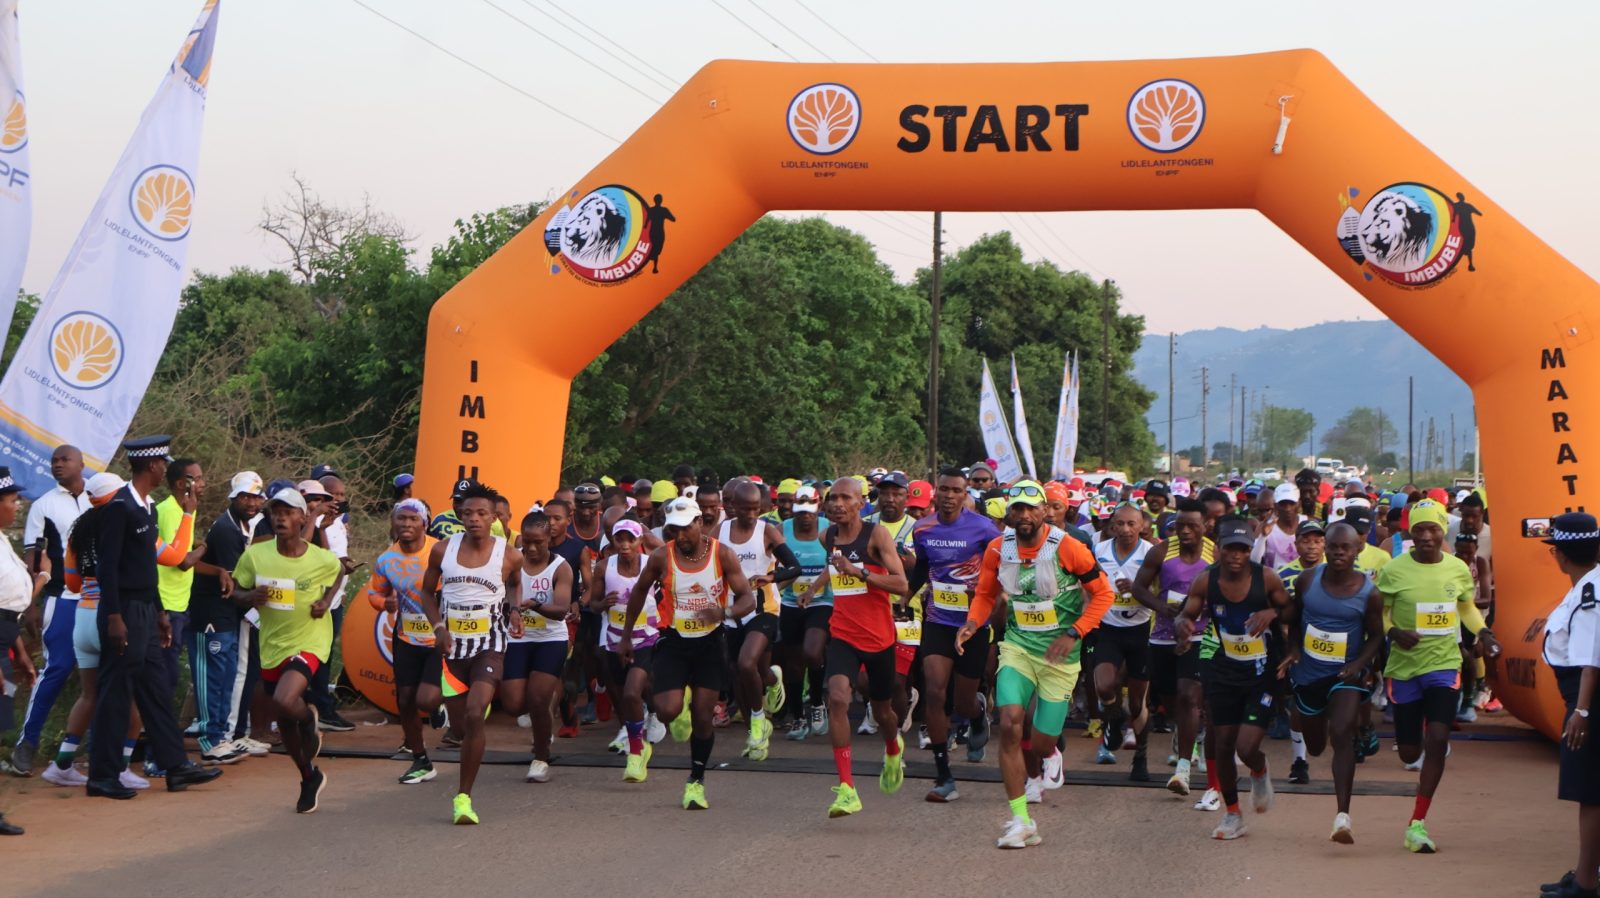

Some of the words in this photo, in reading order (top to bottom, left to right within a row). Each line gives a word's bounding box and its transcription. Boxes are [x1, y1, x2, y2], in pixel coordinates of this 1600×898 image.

[897, 104, 1089, 153] START
[781, 161, 869, 169] LIDLELANTFONGENI
[1120, 158, 1215, 168] LIDLELANTFONGENI
[104, 218, 182, 271] LIDLELANTFONGENI
[593, 240, 651, 280] IMBUBE
[1404, 234, 1462, 283] IMBUBE
[24, 366, 104, 419] LIDLELANTFONGENI
[531, 577, 550, 591] 40
[940, 591, 959, 603] 435
[1023, 612, 1045, 623] 790
[1426, 614, 1449, 625] 126
[410, 621, 430, 631] 786
[456, 620, 478, 631] 730
[1233, 644, 1250, 653] 40
[1312, 638, 1334, 653] 805
